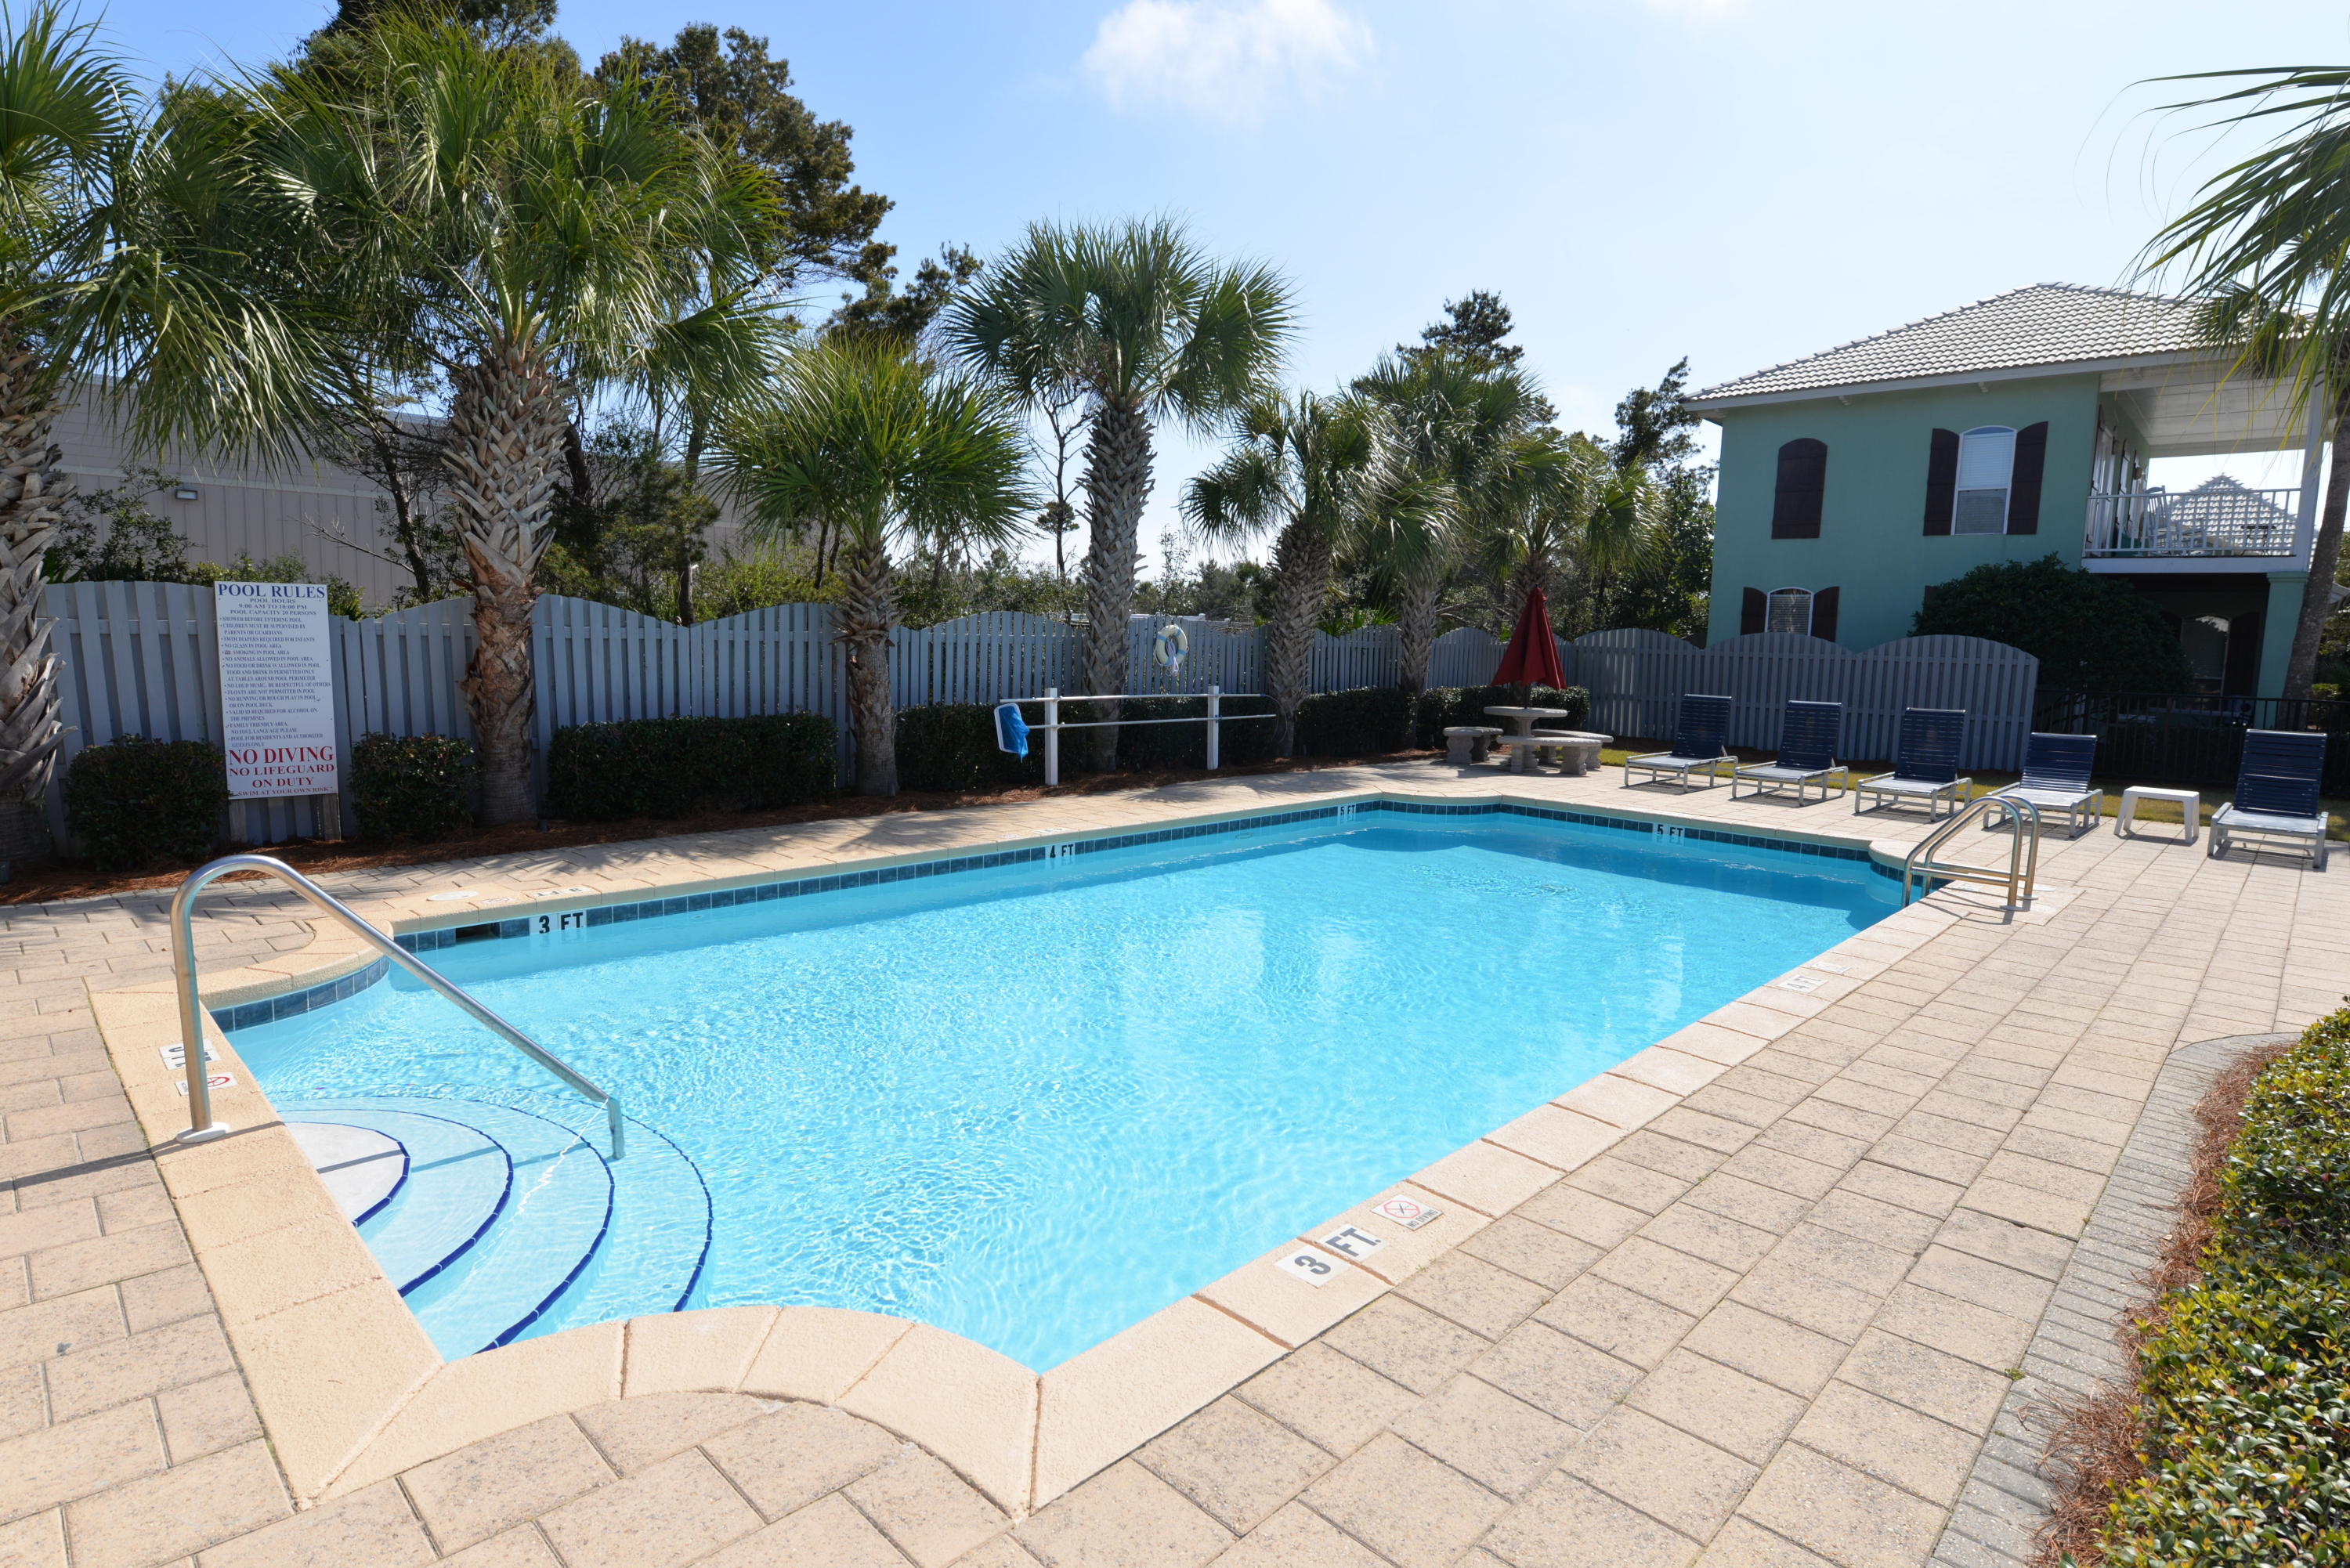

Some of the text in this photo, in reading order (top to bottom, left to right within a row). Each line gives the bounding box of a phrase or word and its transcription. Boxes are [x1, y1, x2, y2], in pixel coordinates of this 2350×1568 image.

[218, 584, 325, 598] POOL RULES
[229, 746, 333, 765] NO DIVING
[230, 764, 334, 777] NO LIFEGUARD
[252, 777, 313, 788] ON DUTY
[1657, 824, 1664, 835] 5
[1050, 845, 1056, 858] 4
[539, 915, 550, 934] 3
[1407, 1209, 1439, 1228] NO DIVING
[1294, 1227, 1381, 1275] 3 FT.
